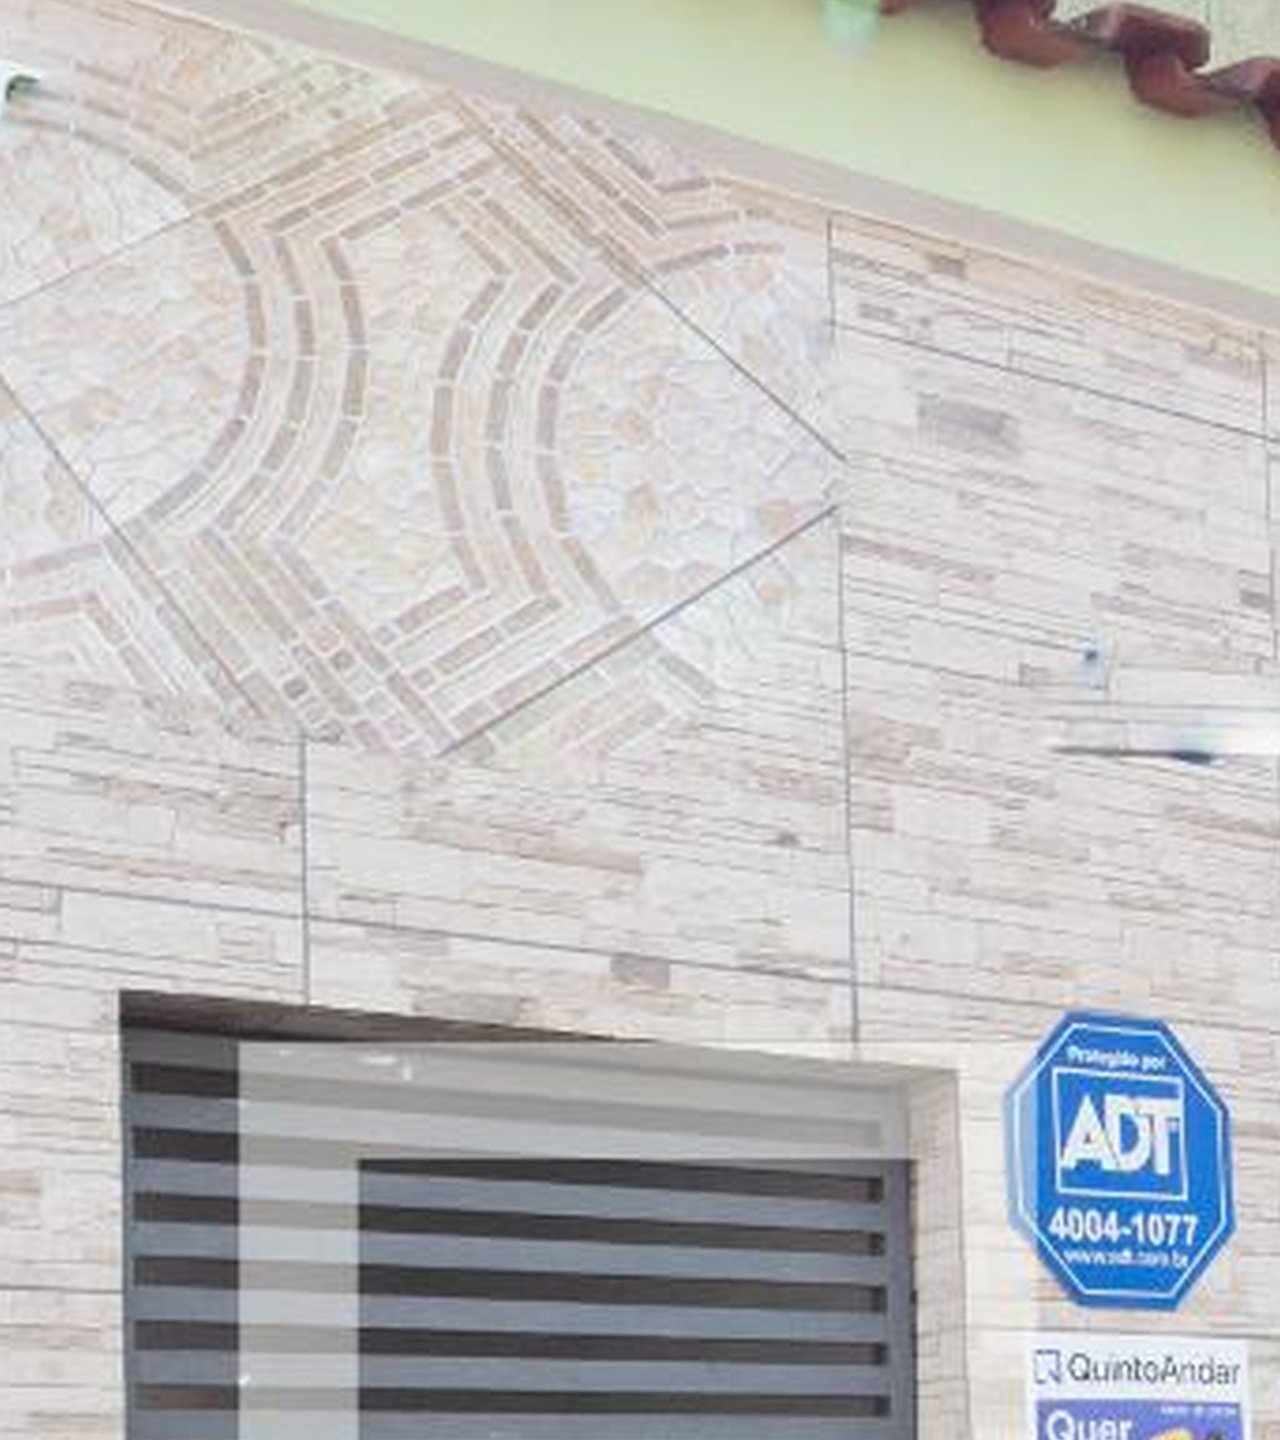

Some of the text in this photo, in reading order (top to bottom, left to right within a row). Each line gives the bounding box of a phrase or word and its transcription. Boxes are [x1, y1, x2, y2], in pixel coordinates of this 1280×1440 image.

[1061, 1094, 1183, 1176] ADT
[1049, 1207, 1198, 1246] 4004-1077
[1068, 1353, 1241, 1385] QuintoAndar
